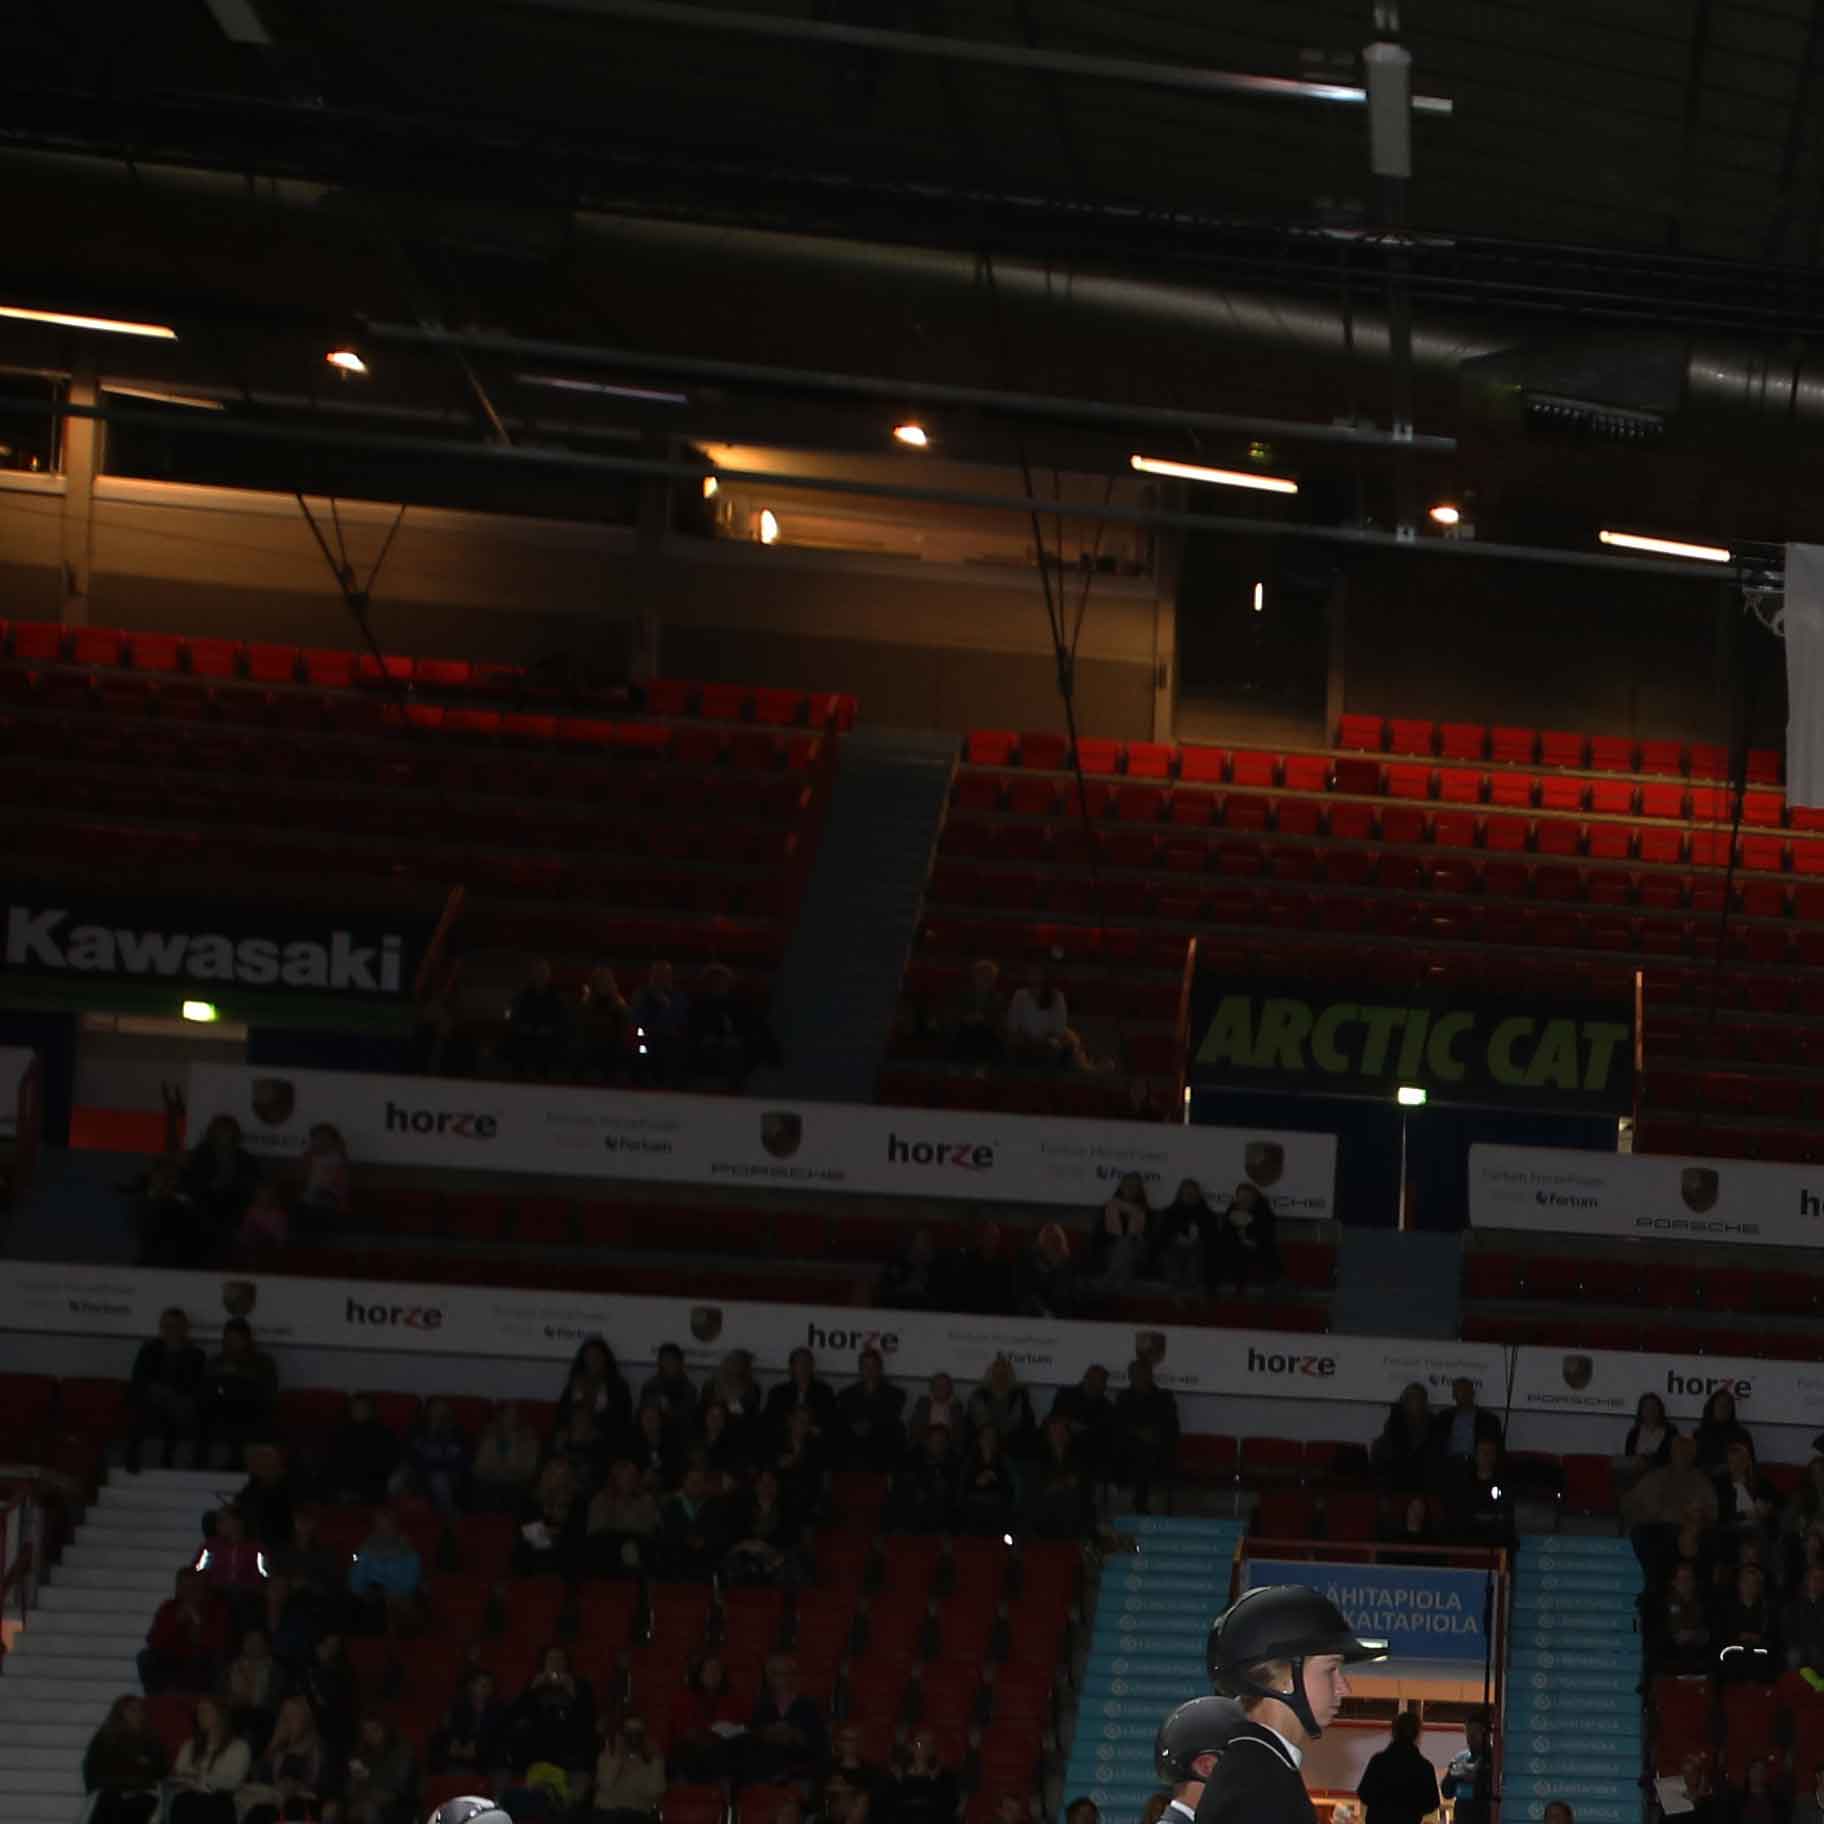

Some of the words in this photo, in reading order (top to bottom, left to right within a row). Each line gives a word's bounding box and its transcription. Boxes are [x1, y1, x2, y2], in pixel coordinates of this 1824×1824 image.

[6, 905, 403, 991] Kawasaki
[1195, 995, 1477, 1083] ARCTIC
[1486, 1016, 1629, 1091] CAT
[386, 1102, 498, 1140] horze
[889, 1131, 995, 1172] horze
[346, 1296, 443, 1330] horze
[1248, 1346, 1337, 1376] horze
[1314, 1577, 1463, 1612] ÄHITAPIOLA
